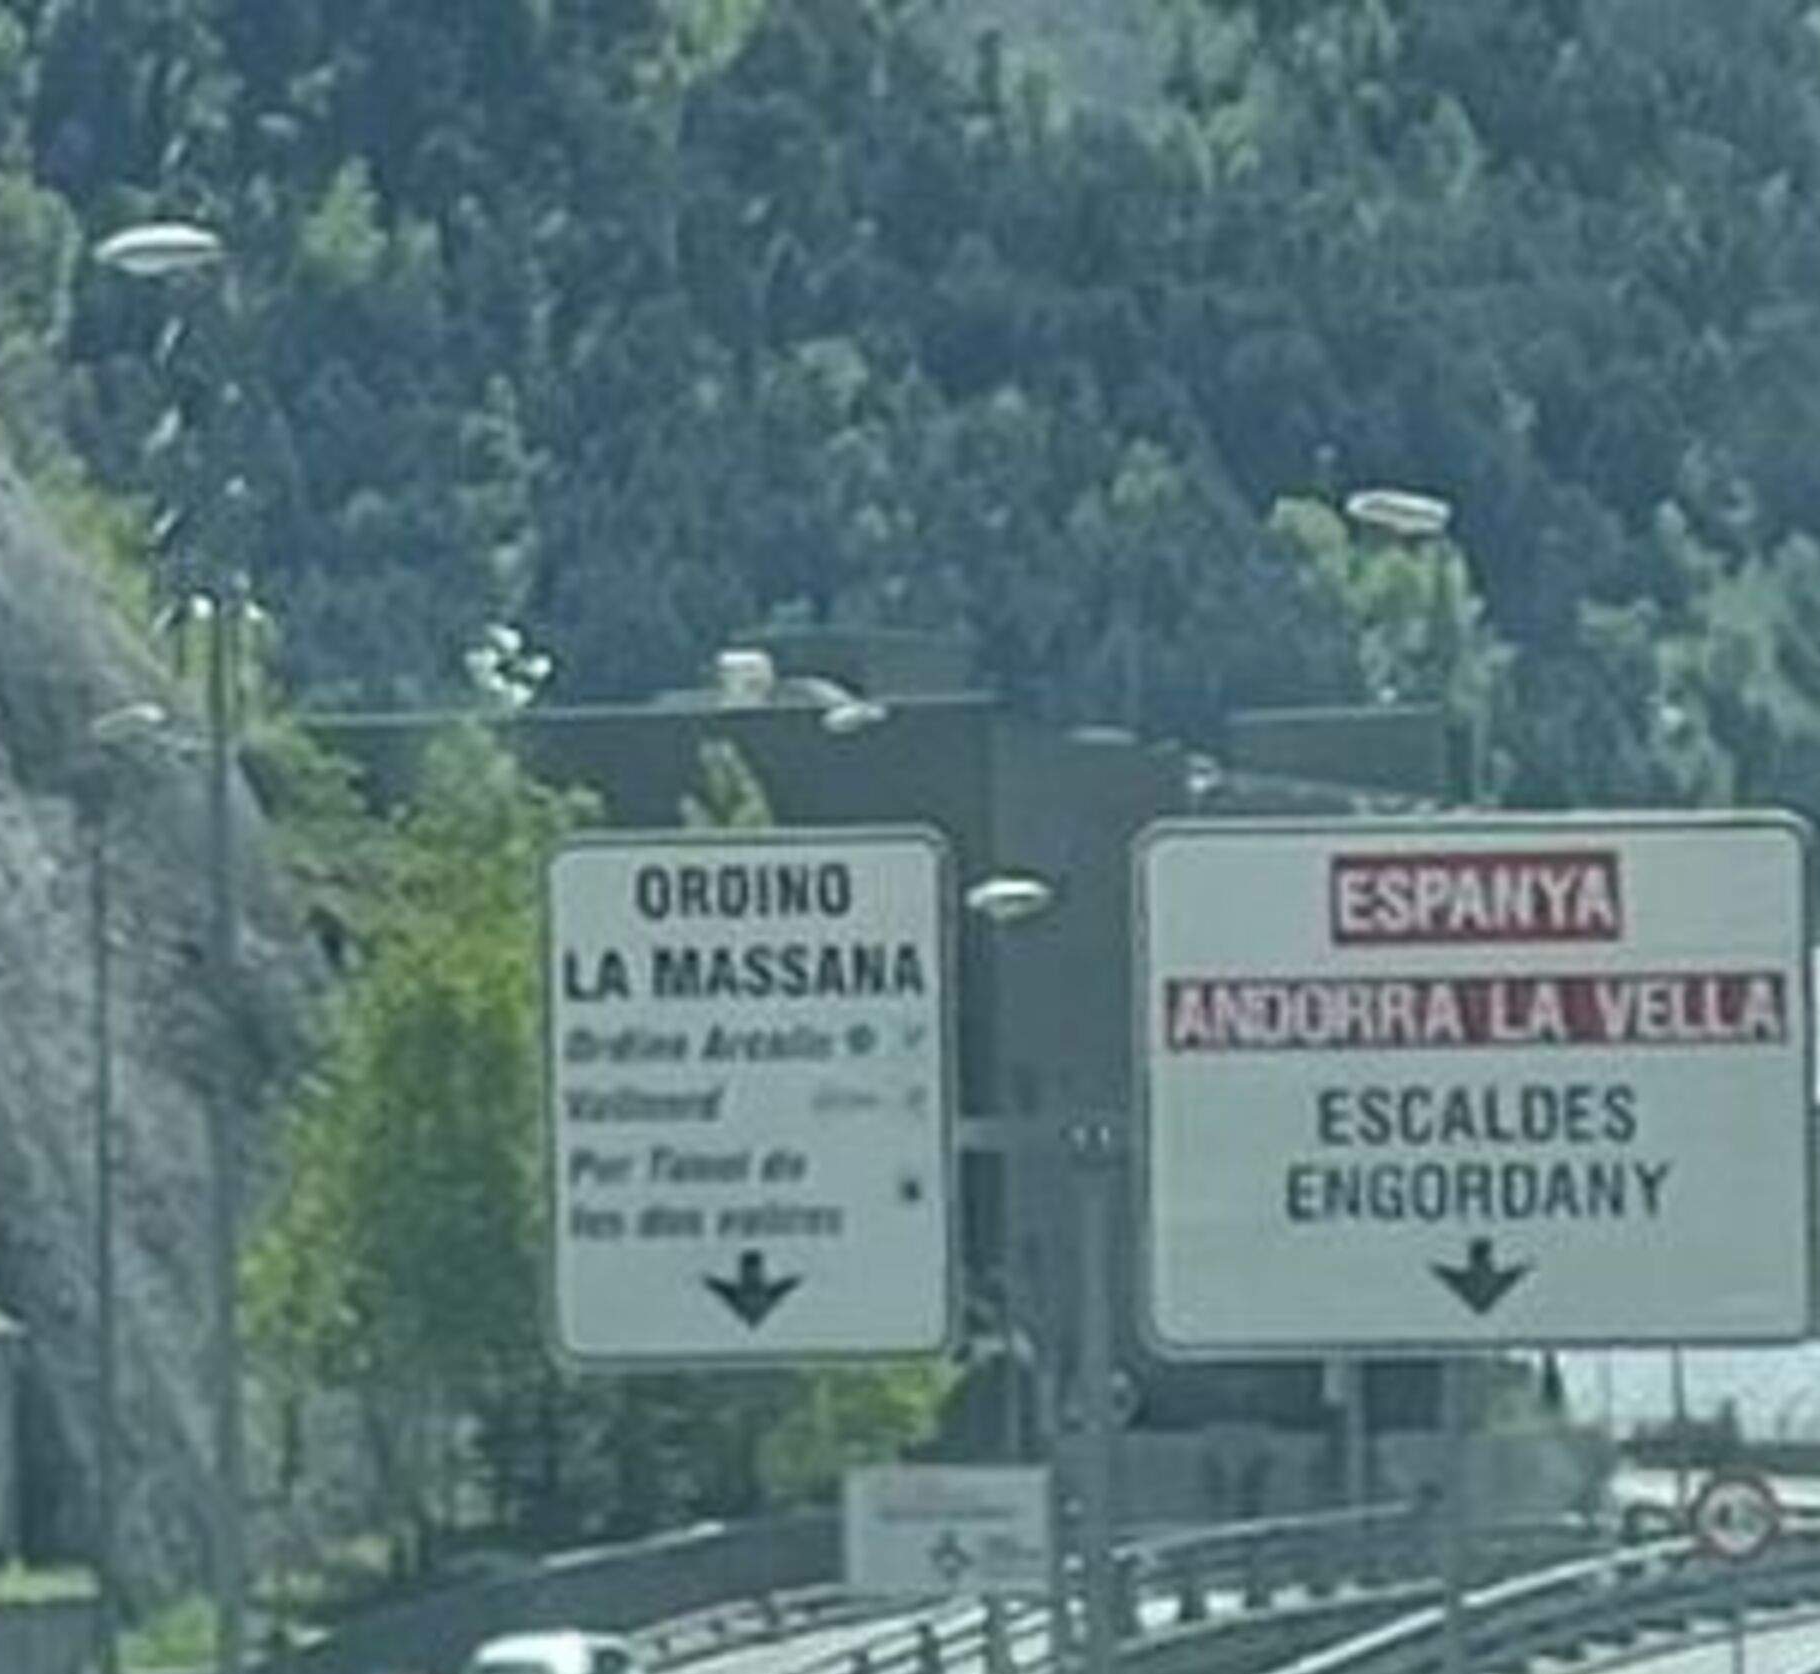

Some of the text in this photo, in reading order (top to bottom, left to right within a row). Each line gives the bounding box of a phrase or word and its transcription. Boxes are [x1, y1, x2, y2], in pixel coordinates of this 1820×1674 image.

[635, 862, 852, 922] ORDINO
[1338, 864, 1616, 934] ESPANYA
[562, 941, 925, 1001] LA MASSANA
[1174, 976, 1780, 1042] ANDORRA LA VELLA
[1316, 1084, 1638, 1147] ESCALDES
[1284, 1161, 1670, 1222] ENGORDANY
